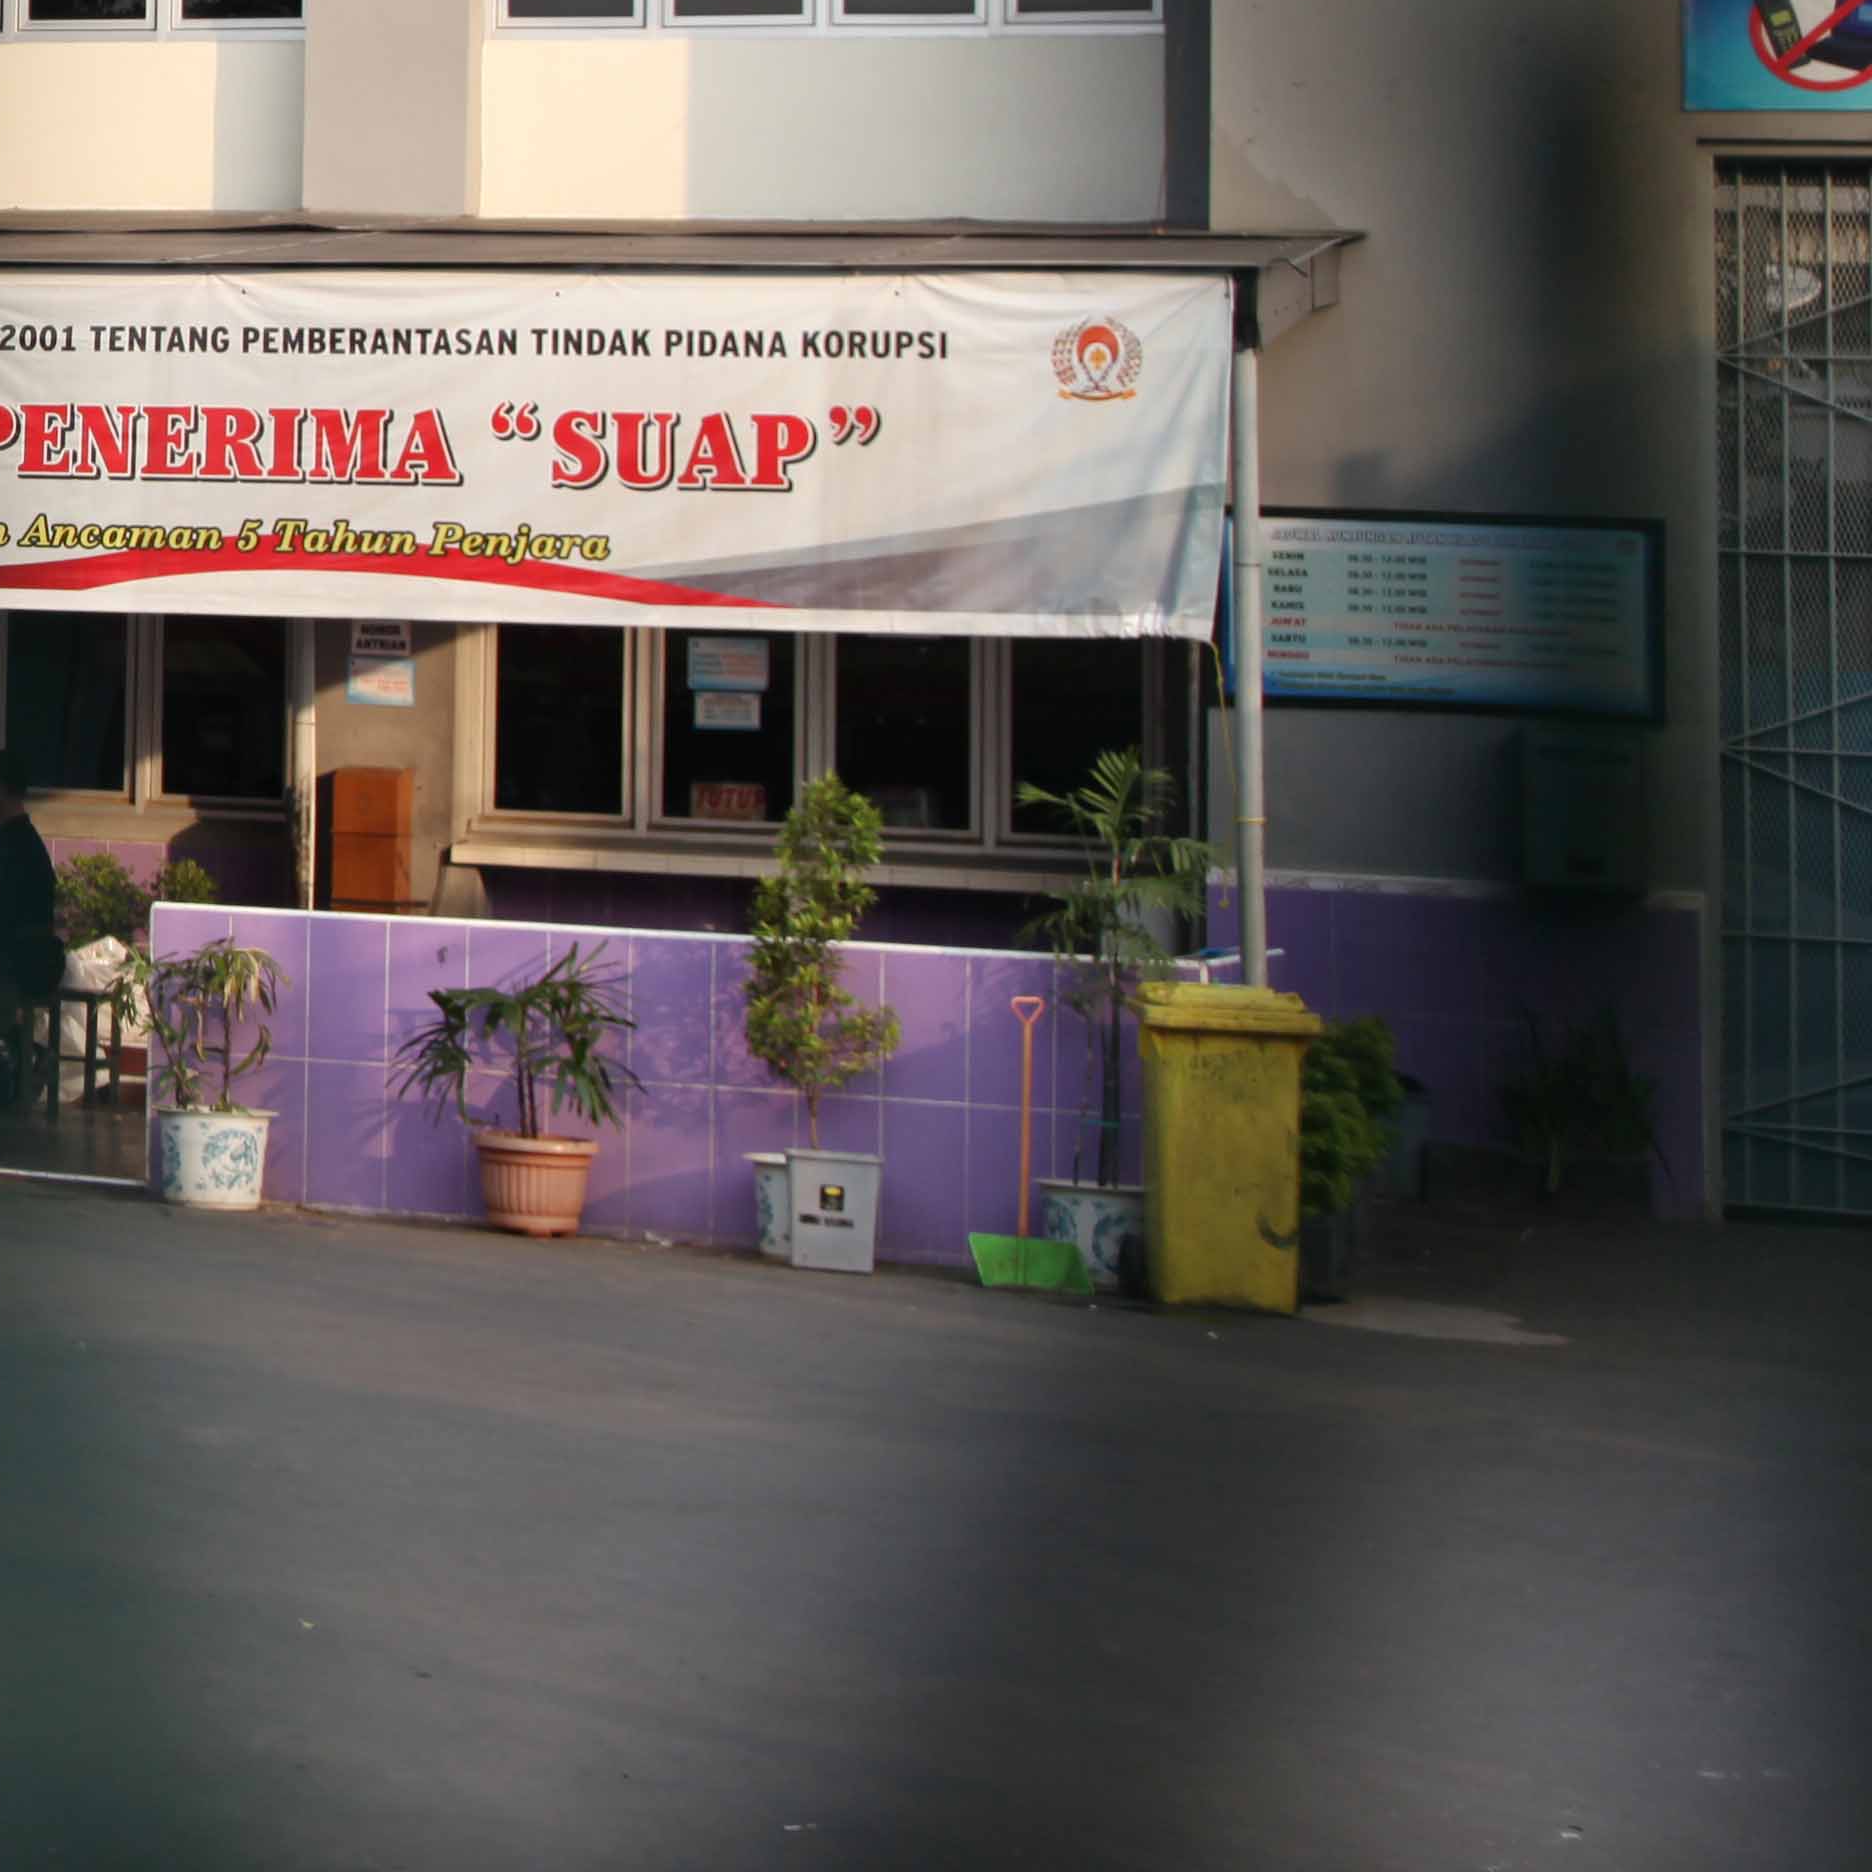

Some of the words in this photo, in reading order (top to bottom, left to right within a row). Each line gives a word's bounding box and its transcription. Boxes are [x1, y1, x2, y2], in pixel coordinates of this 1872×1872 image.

[0, 324, 76, 353] 2001
[92, 324, 230, 354] TENTANG
[242, 326, 518, 357] PEMBERANTASAN
[531, 328, 651, 357] TINDAK
[664, 329, 788, 359] PIDANA
[802, 330, 949, 360] KORUPSI
[19, 514, 223, 552] Ancaman
[236, 518, 260, 552] 5
[271, 518, 417, 555] Tahun
[428, 522, 611, 565] Penjara
